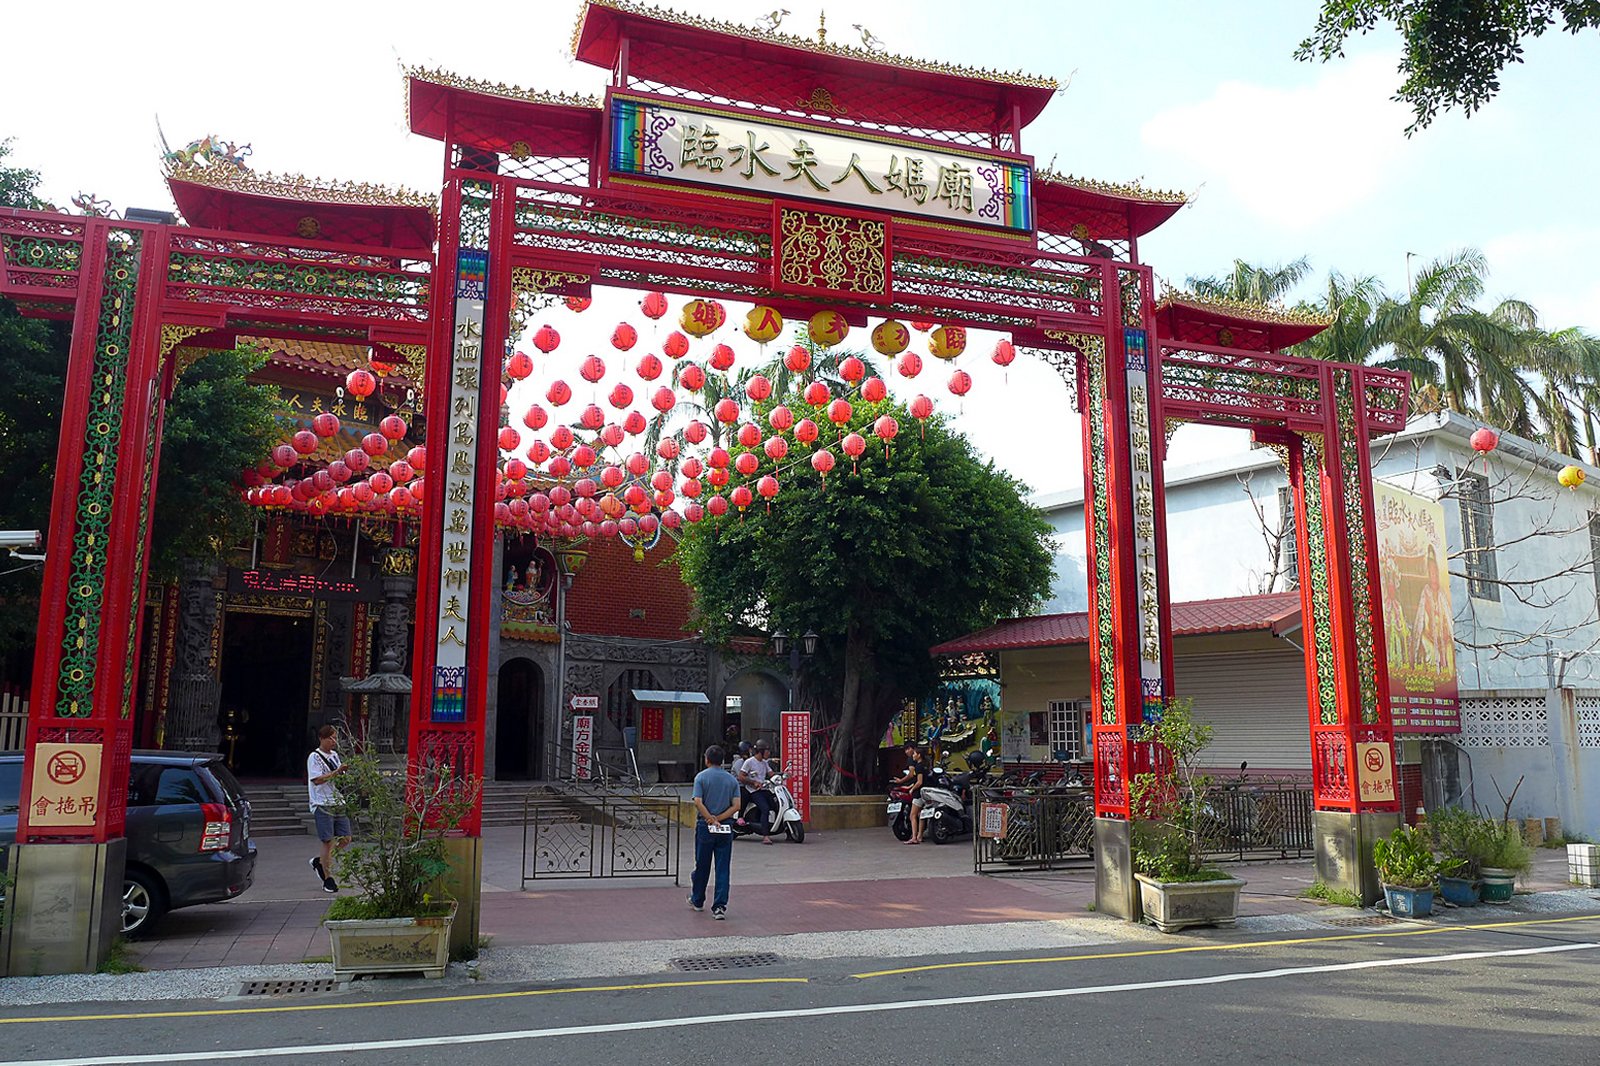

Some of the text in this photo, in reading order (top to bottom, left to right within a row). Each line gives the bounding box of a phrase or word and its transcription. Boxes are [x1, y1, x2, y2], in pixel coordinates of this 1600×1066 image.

[678, 121, 976, 214] 臨水夫人媽廟
[693, 303, 719, 330] 媽
[758, 308, 781, 333] 人
[945, 328, 966, 350] 臨
[1361, 778, 1393, 796] 會拖吊
[32, 795, 96, 817] 會拖吊
